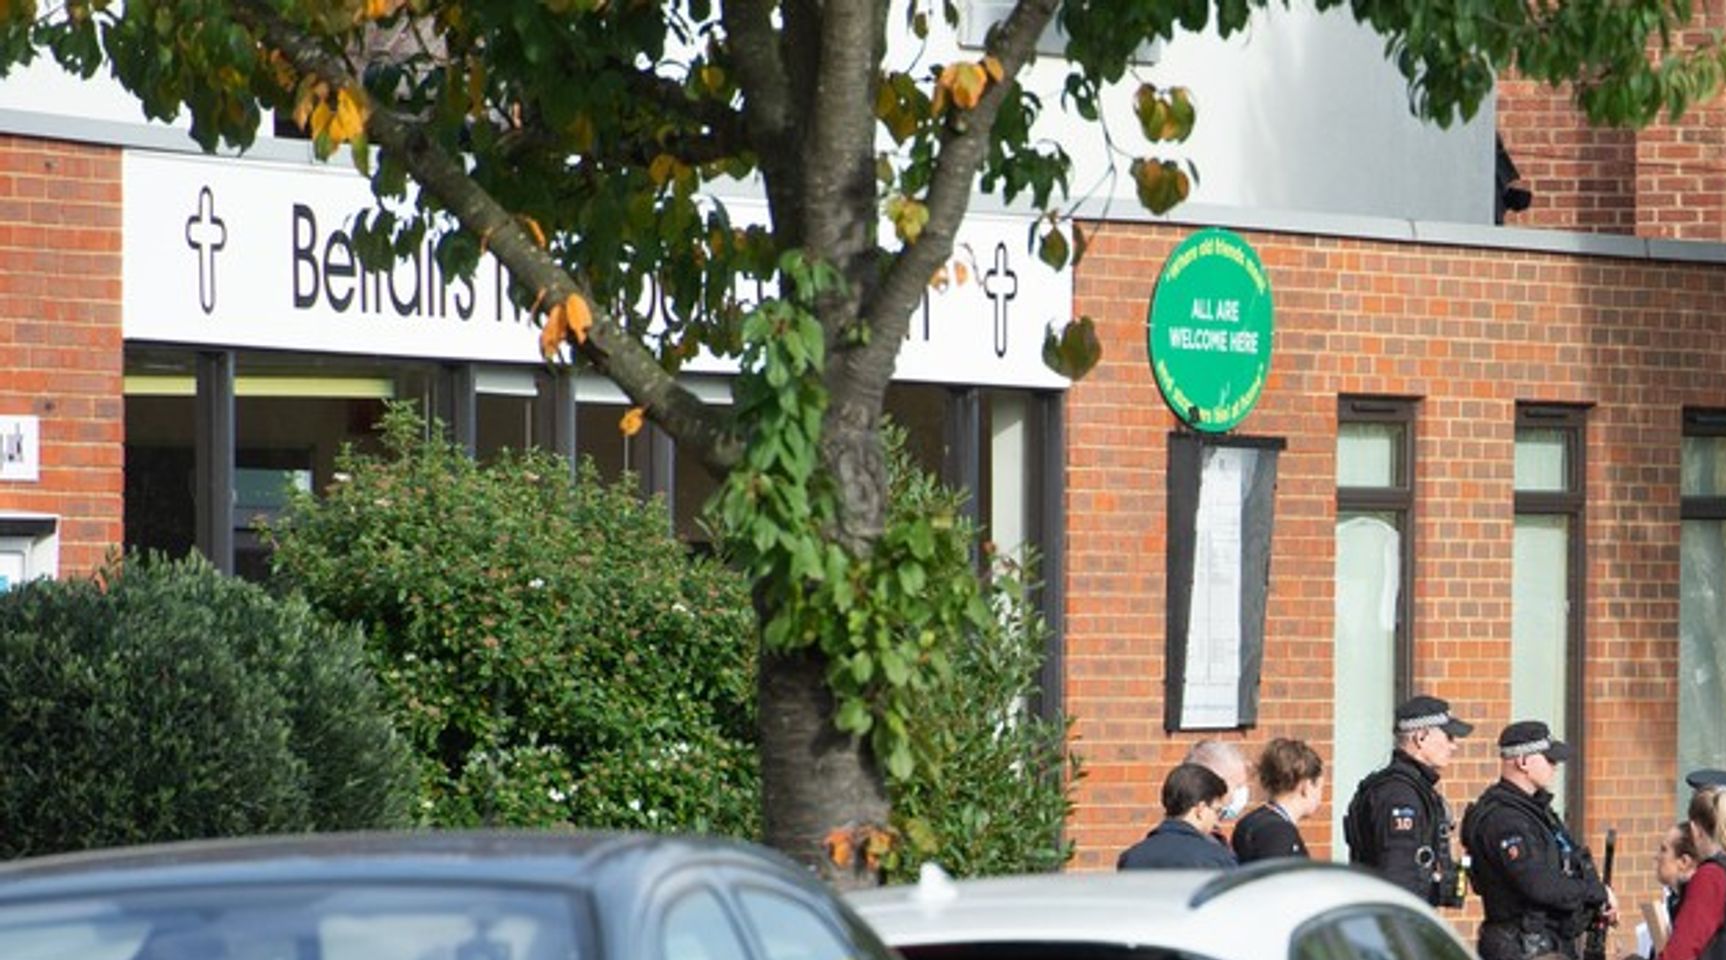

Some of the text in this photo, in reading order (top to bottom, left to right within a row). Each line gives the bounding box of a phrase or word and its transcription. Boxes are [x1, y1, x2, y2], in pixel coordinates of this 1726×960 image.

[1191, 298, 1240, 322] ALL ARE
[1168, 326, 1259, 355] WELCOME HERE
